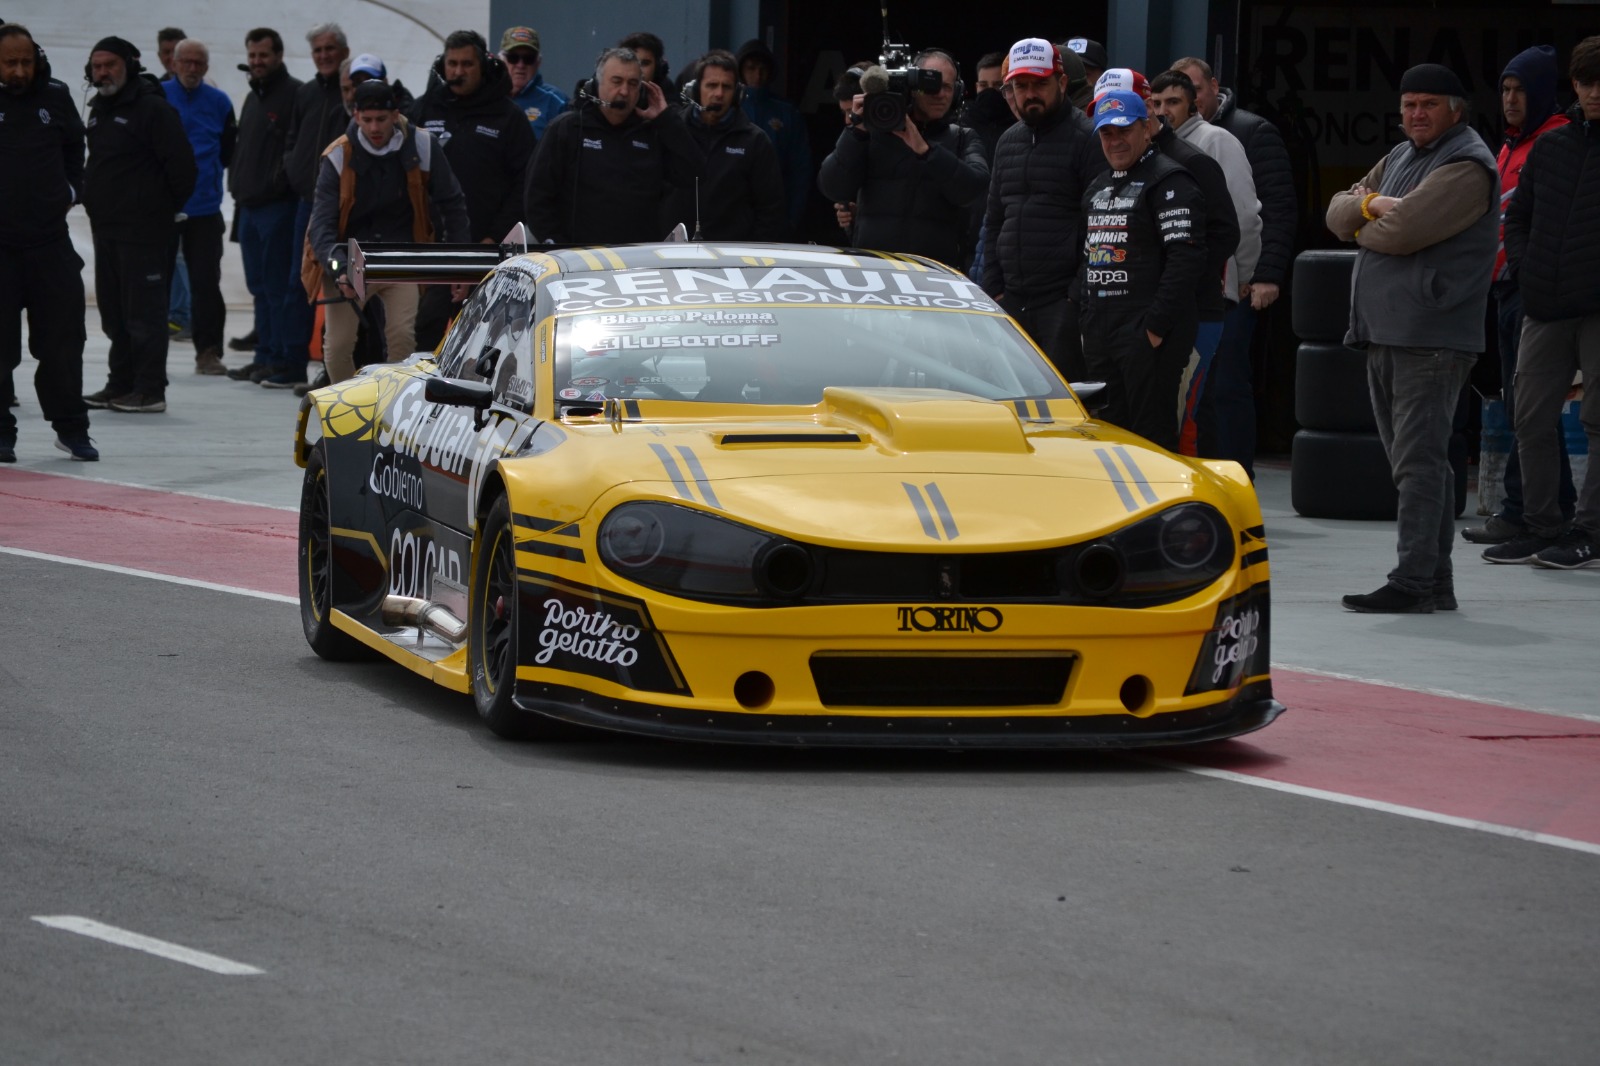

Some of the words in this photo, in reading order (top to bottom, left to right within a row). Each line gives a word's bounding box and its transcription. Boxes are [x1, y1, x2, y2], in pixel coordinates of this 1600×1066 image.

[1262, 26, 1600, 92] RENAU
[1165, 208, 1190, 218] PICHETTI
[546, 267, 980, 300] RENAULT
[556, 291, 996, 312] CONCESIONARIOS
[600, 313, 681, 325] Blanca
[685, 310, 773, 322] Paloma
[369, 452, 423, 510] Gobierno
[897, 606, 1004, 634] TORINO
[535, 631, 638, 667] gelatto
